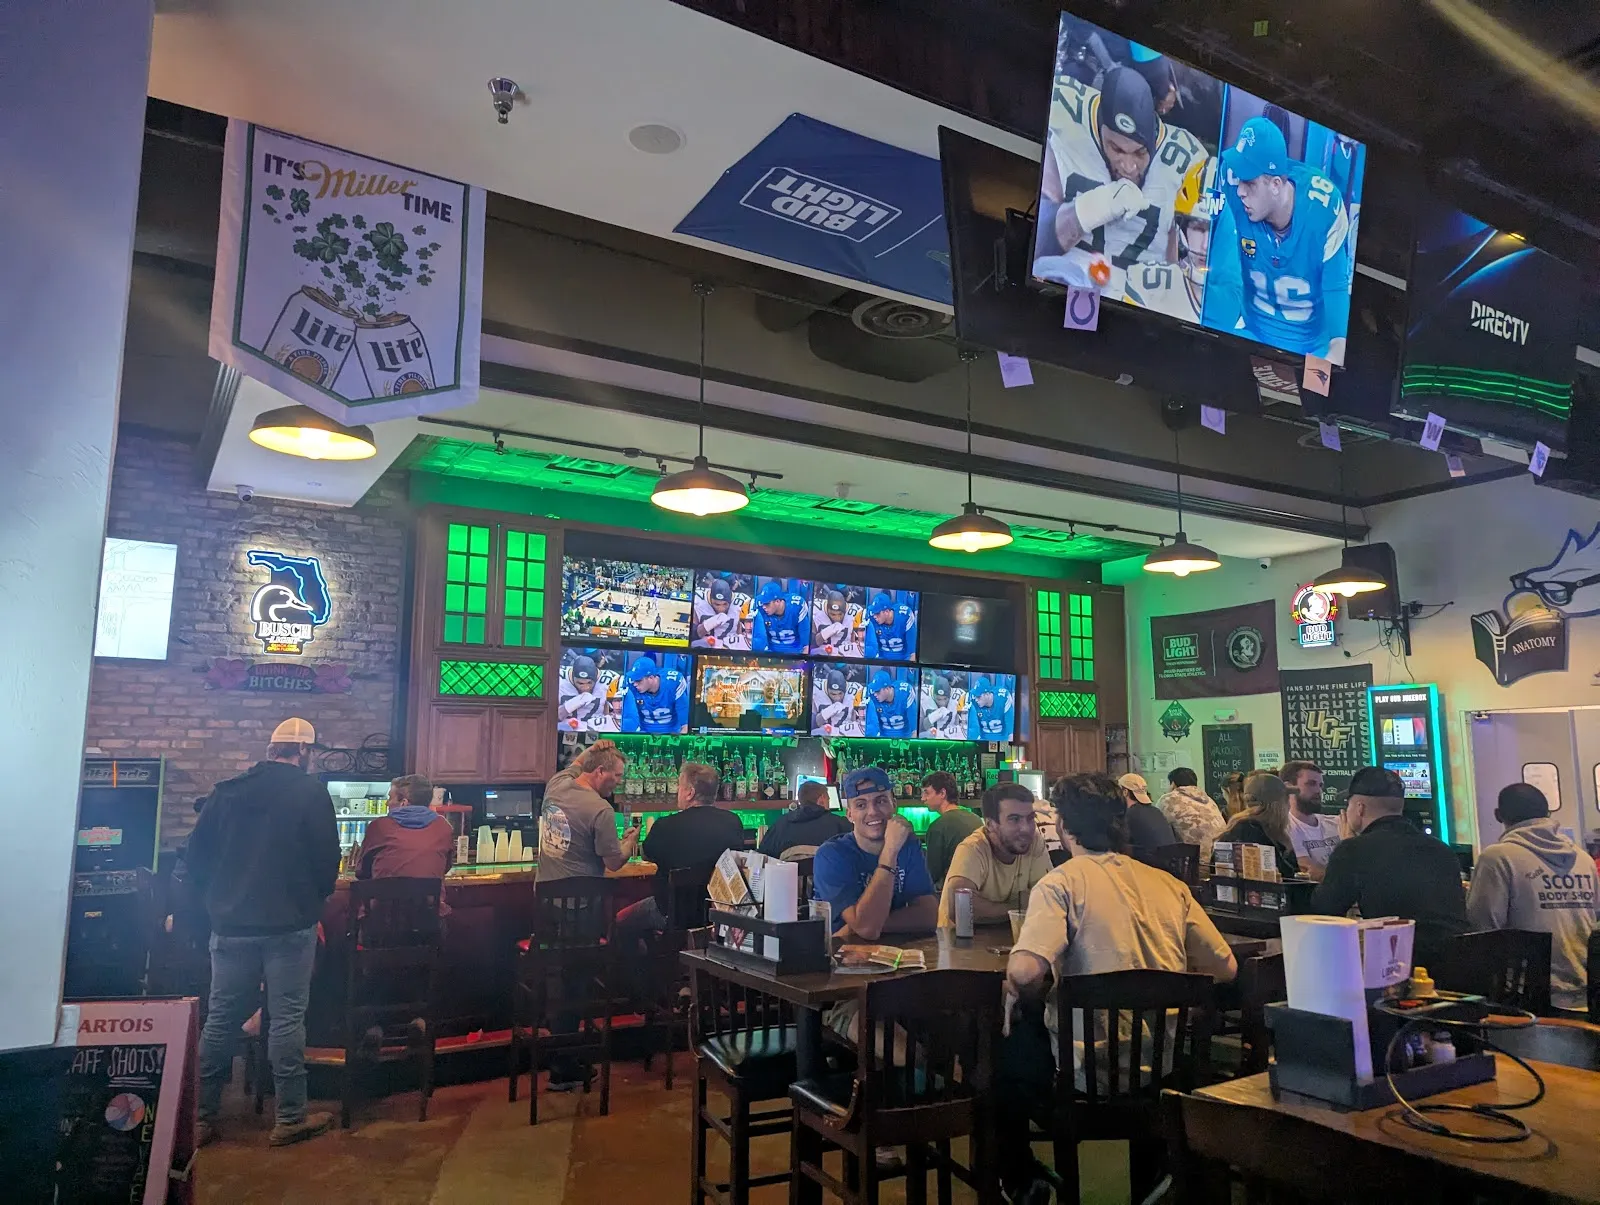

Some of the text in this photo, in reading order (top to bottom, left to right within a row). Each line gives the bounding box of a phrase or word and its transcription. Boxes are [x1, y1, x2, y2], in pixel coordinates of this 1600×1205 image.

[264, 153, 454, 223] IT'S Miller TIME
[767, 175, 890, 226] LIGHT
[1205, 190, 1227, 217] TNF
[771, 196, 858, 232] BUD
[1250, 271, 1314, 322] 16
[290, 307, 352, 352] Lite
[1471, 300, 1529, 346] DIRECTV
[367, 335, 423, 373] Lite
[258, 621, 312, 640] BUSCH
[1165, 645, 1196, 658] LIGHT
[1170, 637, 1191, 648] BUD
[1512, 636, 1557, 656] ANATOMY
[249, 676, 313, 690] BITCHES
[1375, 693, 1427, 703] PLAY OUR JUKEBOX
[1219, 733, 1232, 743] ALL
[1307, 710, 1351, 748] UCF
[1212, 759, 1241, 770] WILL BE
[1542, 874, 1591, 890] SCOTT
[1538, 891, 1568, 901] BODY
[78, 1018, 154, 1033] ARTOIS
[107, 1047, 162, 1077] SHOTS!
